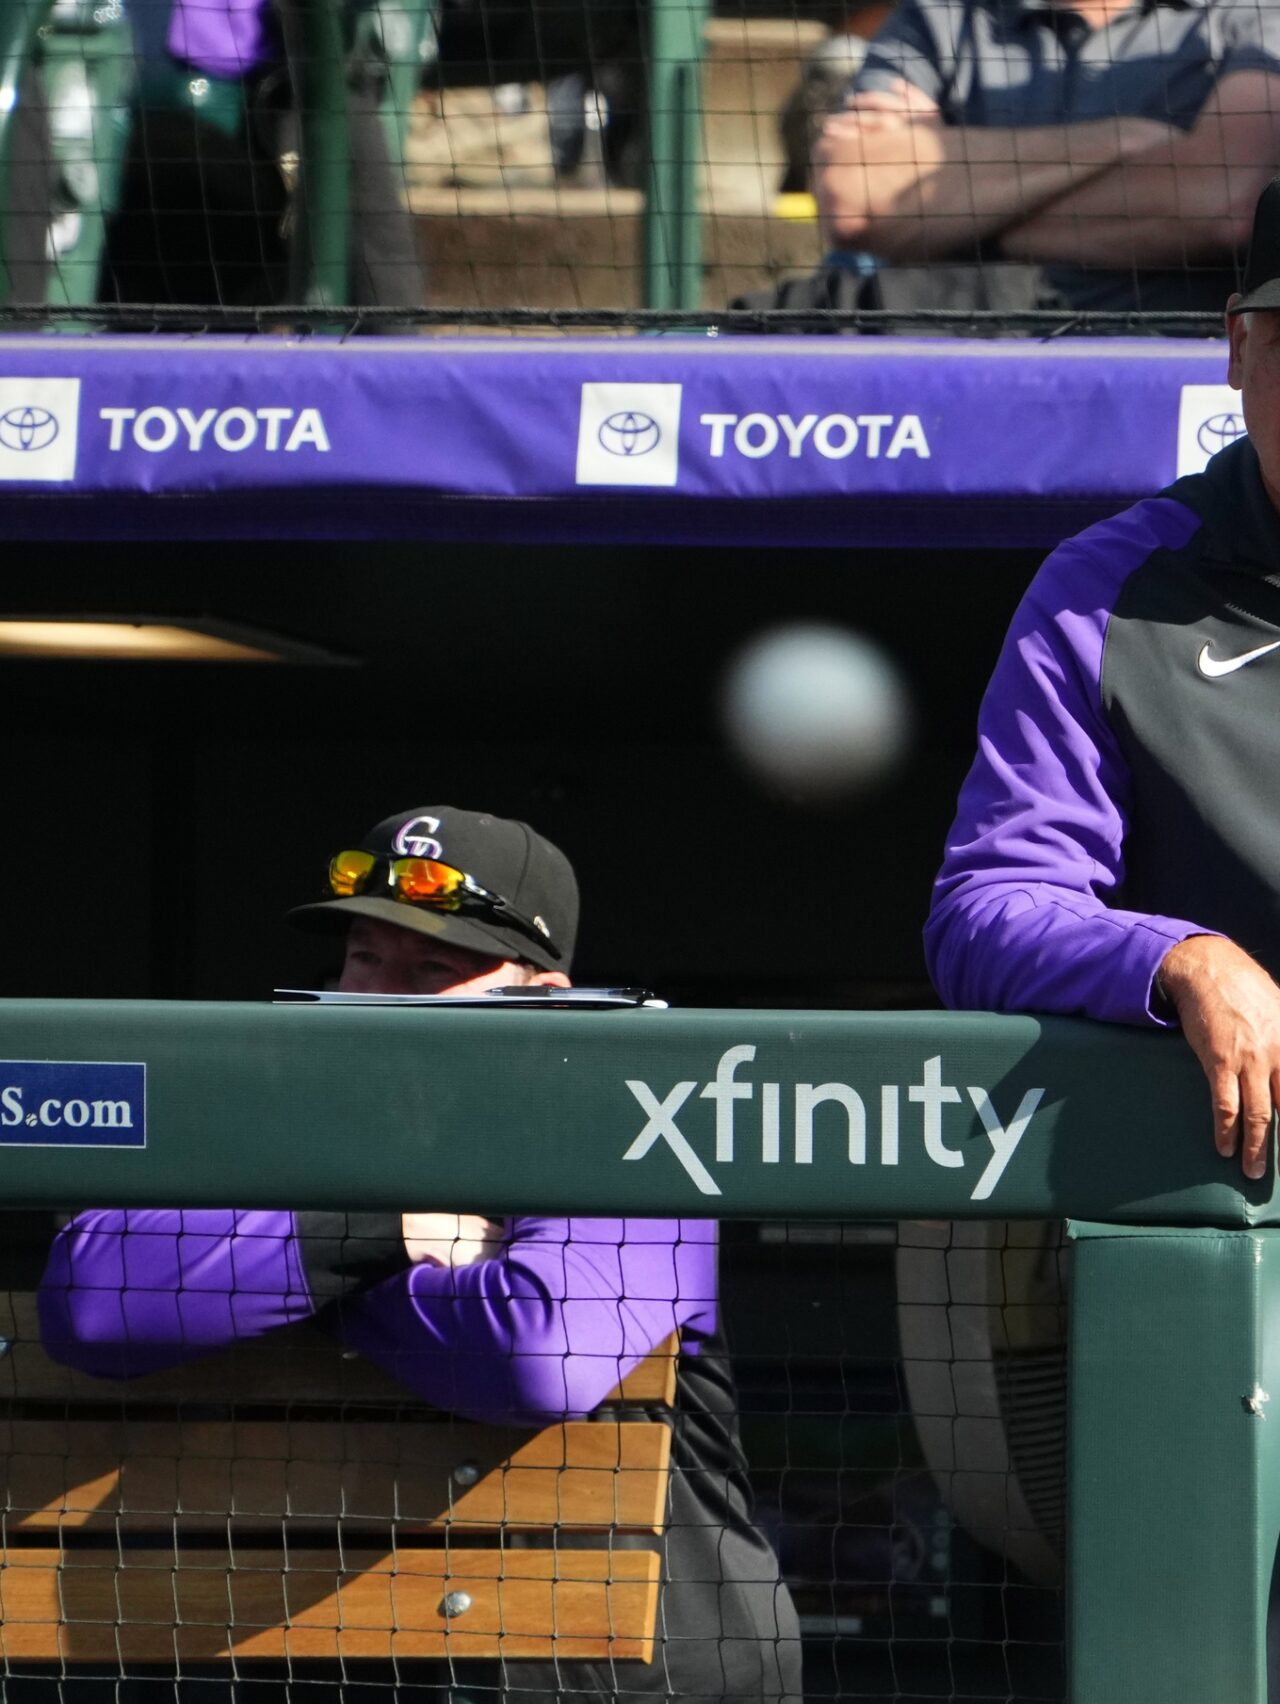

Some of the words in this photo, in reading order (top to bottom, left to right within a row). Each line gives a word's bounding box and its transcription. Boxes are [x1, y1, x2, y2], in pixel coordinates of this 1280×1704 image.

[99, 406, 331, 452] TOYOTA
[700, 412, 931, 460] TOYOTA
[621, 1044, 1046, 1200] xfinity
